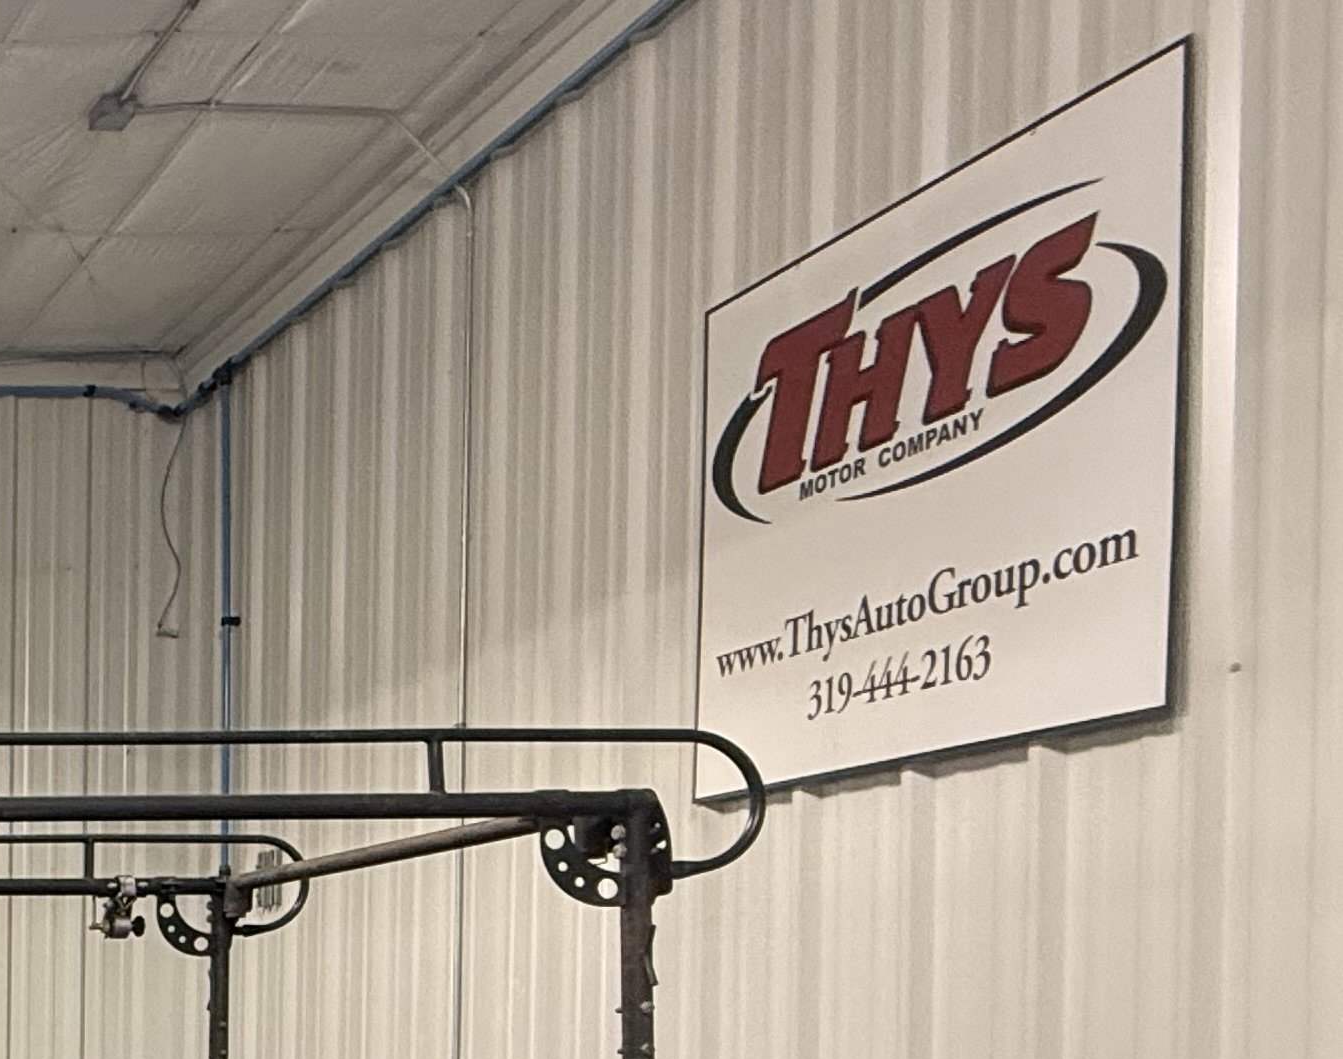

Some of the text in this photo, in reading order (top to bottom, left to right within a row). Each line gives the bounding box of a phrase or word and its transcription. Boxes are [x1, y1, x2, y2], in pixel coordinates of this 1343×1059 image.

[754, 211, 1100, 495] THYS
[799, 408, 984, 501] MOTOR COMPANY
[716, 529, 1139, 678] www.ThysAutoGroup.com
[807, 635, 991, 721] 319-444-2163
